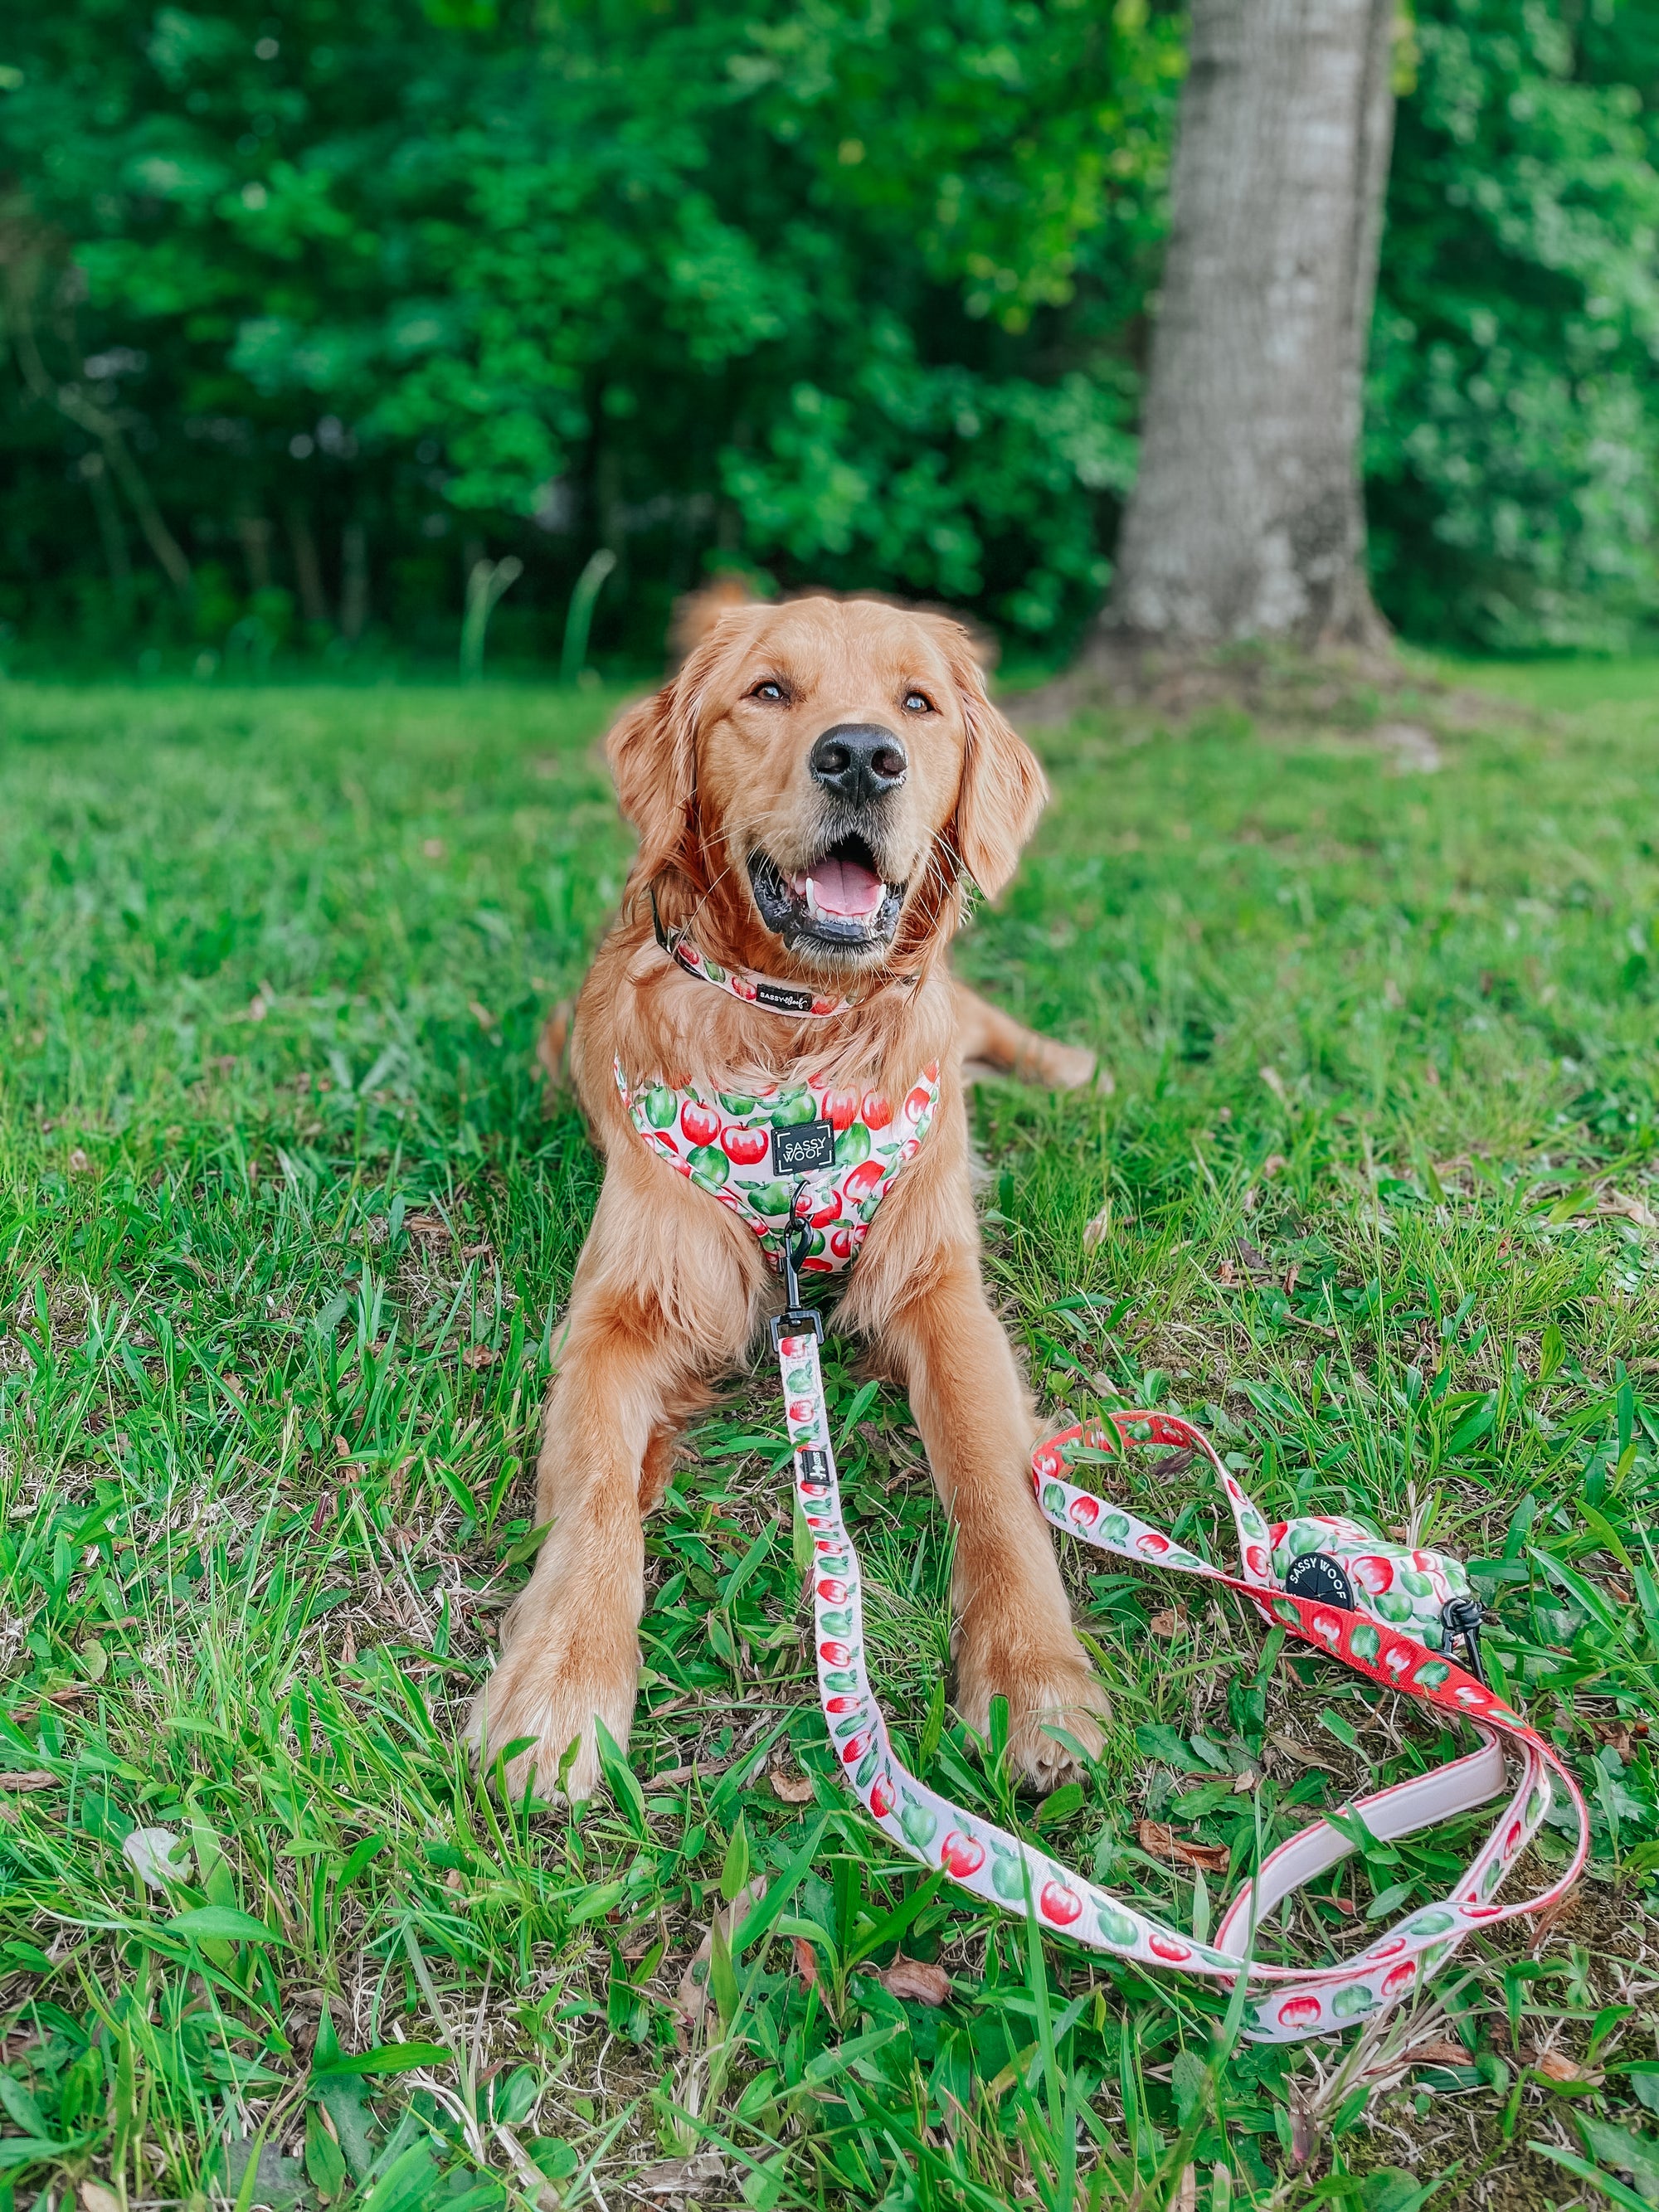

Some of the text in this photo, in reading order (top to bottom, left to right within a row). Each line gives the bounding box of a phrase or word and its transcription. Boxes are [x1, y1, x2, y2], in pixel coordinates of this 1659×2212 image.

[760, 991, 785, 1003] SASSY
[785, 1136, 826, 1154] SASSY
[1290, 1557, 1347, 1600] SASSY WOOF
